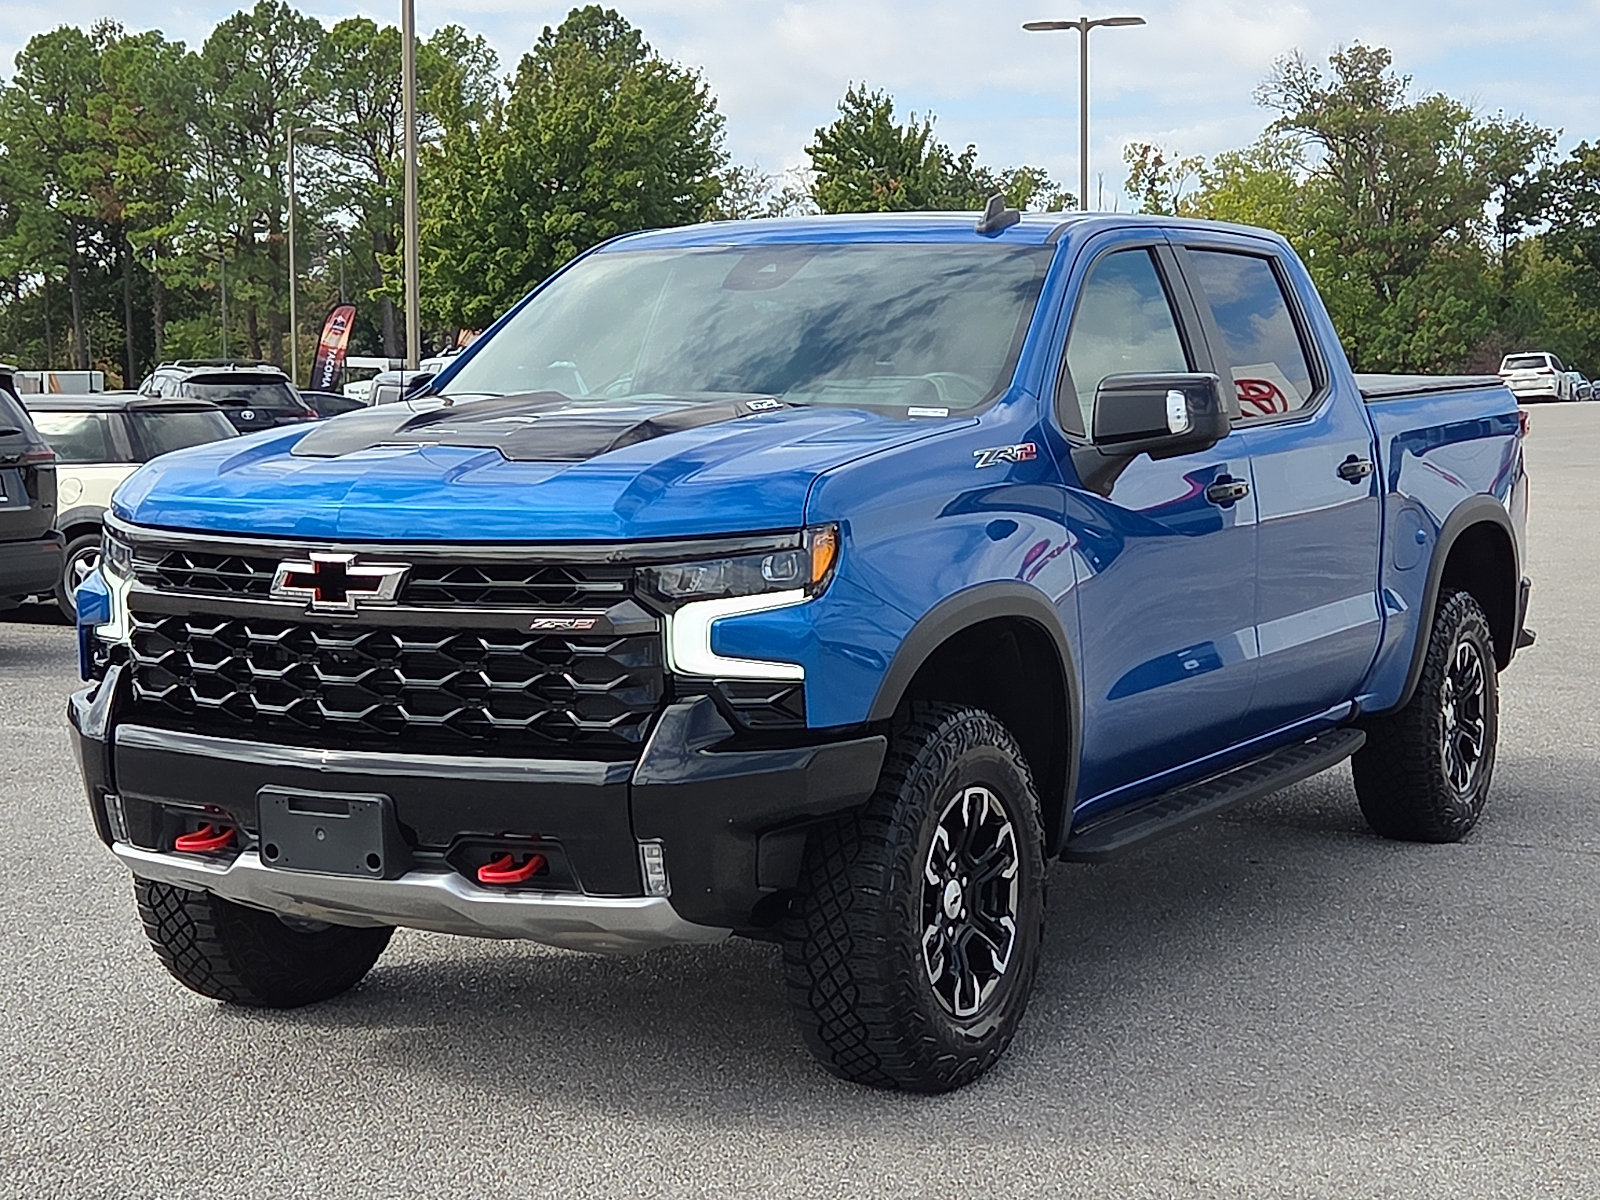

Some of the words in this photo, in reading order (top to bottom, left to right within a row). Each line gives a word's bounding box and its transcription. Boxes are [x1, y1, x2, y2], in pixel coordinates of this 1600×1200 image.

[321, 348, 338, 388] TACOMA
[973, 443, 1037, 469] ZR2
[530, 618, 596, 630] ZR2
